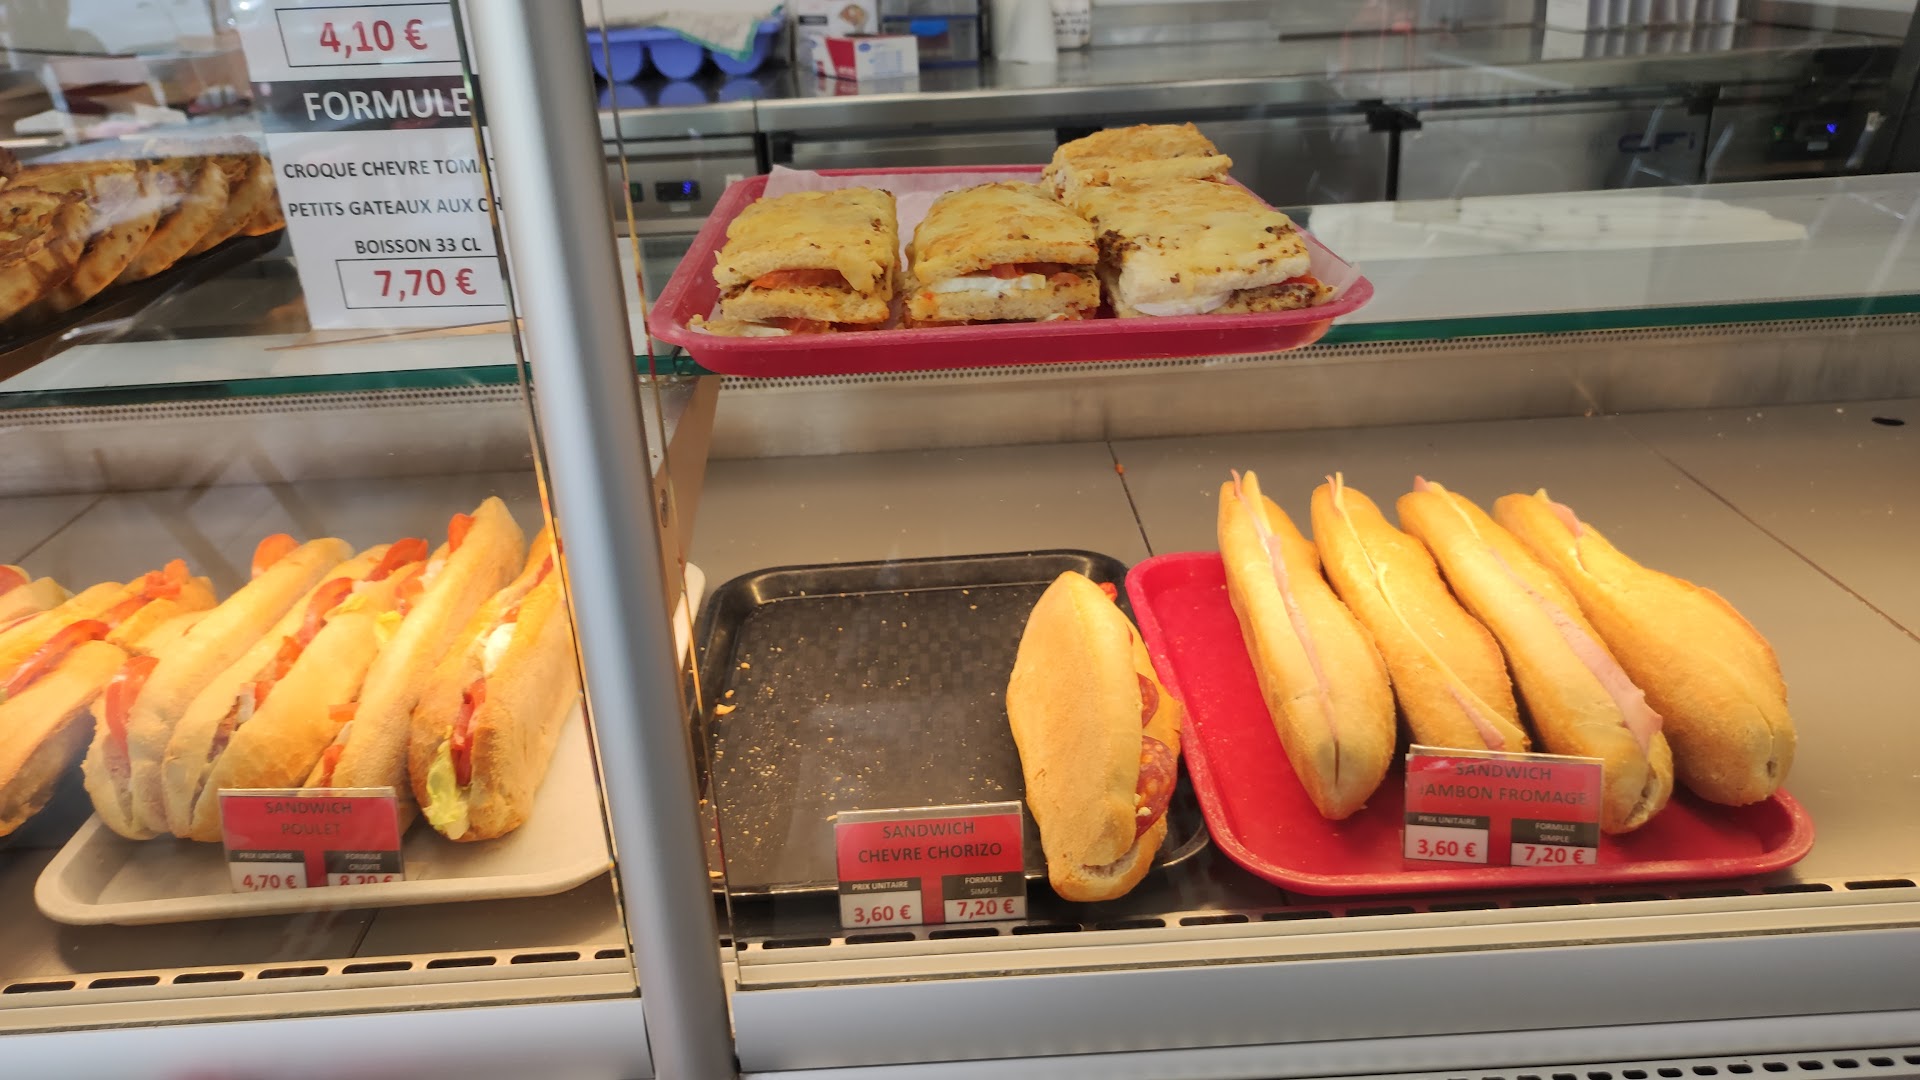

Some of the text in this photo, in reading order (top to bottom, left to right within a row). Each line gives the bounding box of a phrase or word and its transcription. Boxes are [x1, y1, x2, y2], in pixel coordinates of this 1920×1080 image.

[320, 18, 428, 58] 4,10 €
[303, 86, 472, 121] FORMULE
[283, 162, 357, 180] CROQUE
[362, 160, 430, 176] CHEVRE
[288, 201, 344, 217] PETITS
[349, 199, 432, 216] GATEAUX
[437, 198, 473, 213] AUX
[355, 237, 481, 254] BOISSON 33 CL
[374, 267, 477, 302] 7,70 €
[1456, 763, 1552, 780] SANDWICH
[1499, 787, 1586, 804] FROMAGE
[265, 802, 352, 814] SANDWICH
[281, 823, 341, 835] POULET
[1418, 815, 1476, 826] PRIX UNITAIRE
[1535, 822, 1576, 832] FORMULE
[883, 821, 975, 839] SANDWICH
[1539, 834, 1570, 843] SIMPLE
[239, 852, 257, 860] PRIX
[858, 842, 1002, 863] CHEVRE CHORIZO
[1417, 839, 1477, 857] 3,60 €
[1525, 846, 1585, 864] 7,20 €
[243, 874, 297, 891] 4,70 €
[851, 880, 909, 891] PRIX UNITAIRE
[964, 875, 1003, 884] FORMULE
[970, 887, 998, 896] SIMPLE
[854, 905, 912, 925] 3,60 €
[957, 898, 1015, 920] 7,20 €
